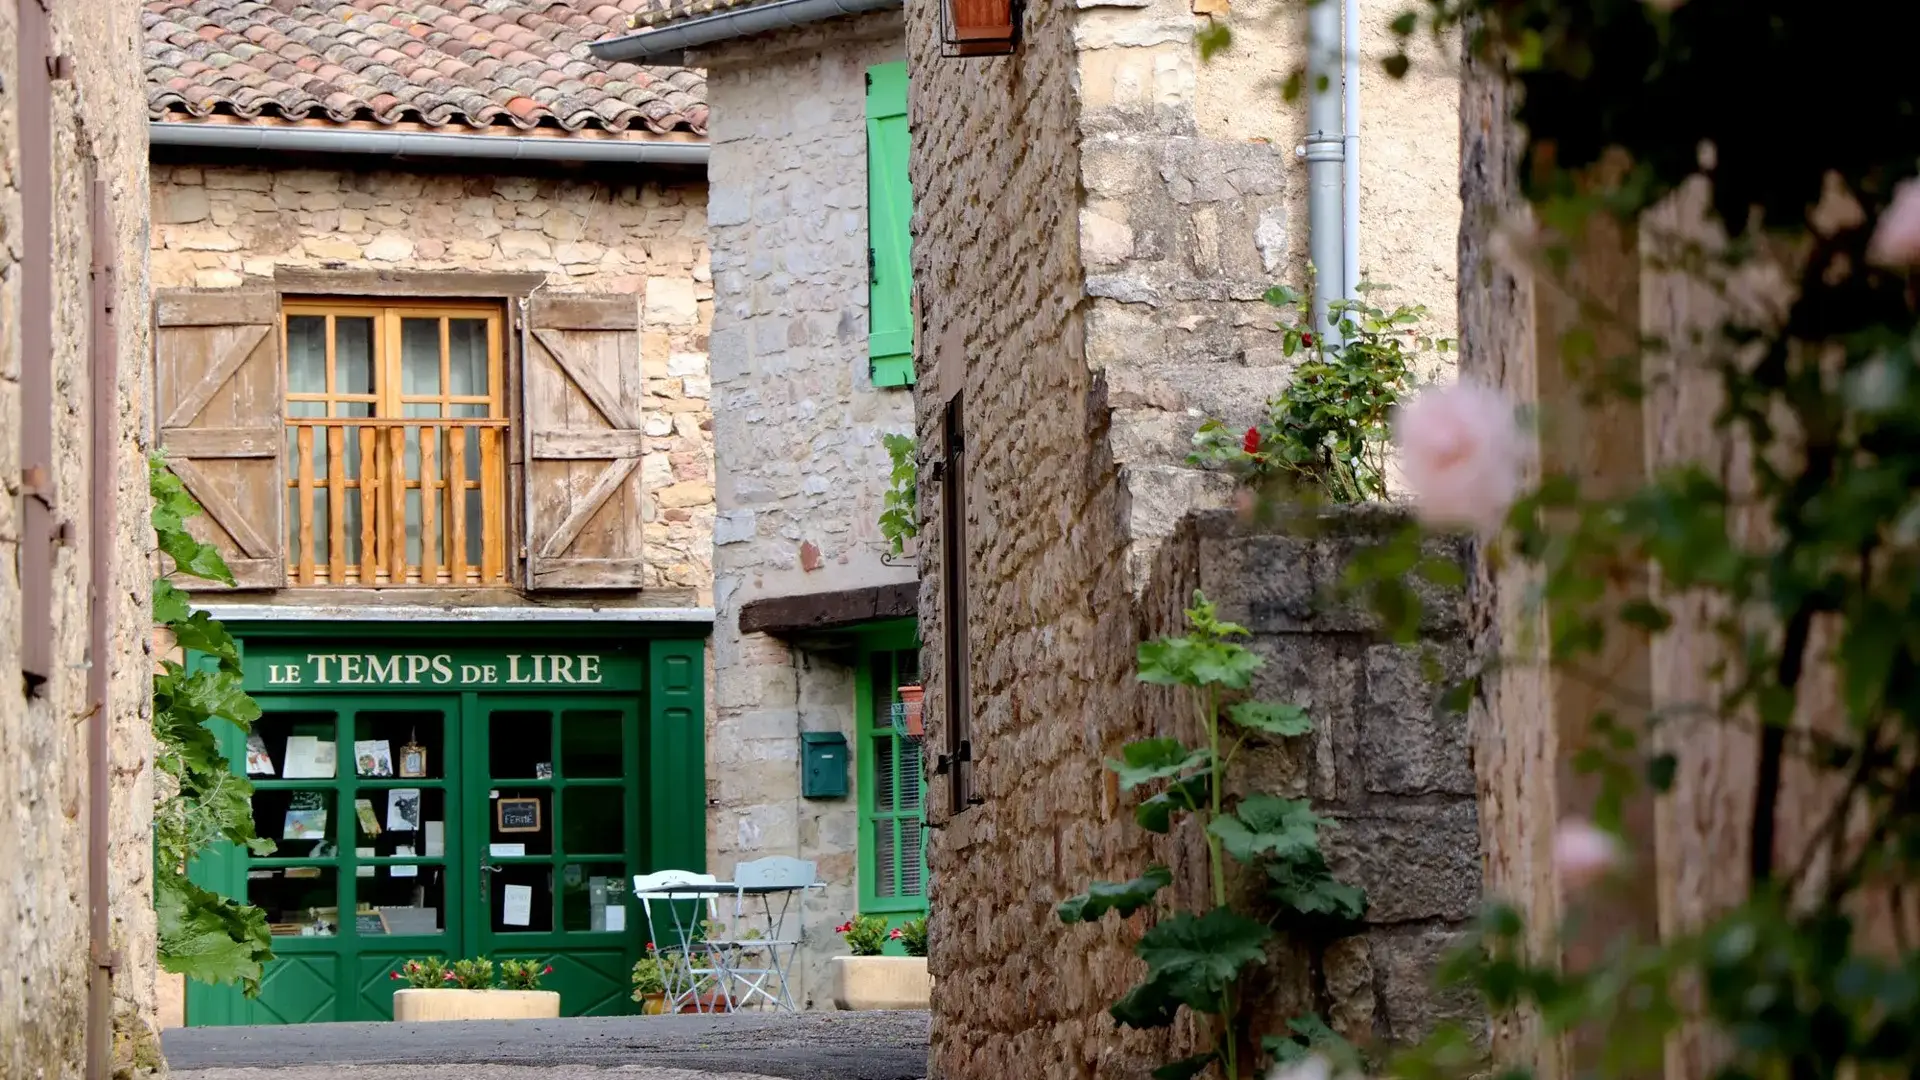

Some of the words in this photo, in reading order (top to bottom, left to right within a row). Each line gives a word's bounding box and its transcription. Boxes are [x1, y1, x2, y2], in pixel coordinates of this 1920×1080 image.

[268, 664, 302, 684] LE
[307, 653, 453, 684] TEMPS
[460, 664, 498, 684] DE
[506, 654, 602, 684] LIRE
